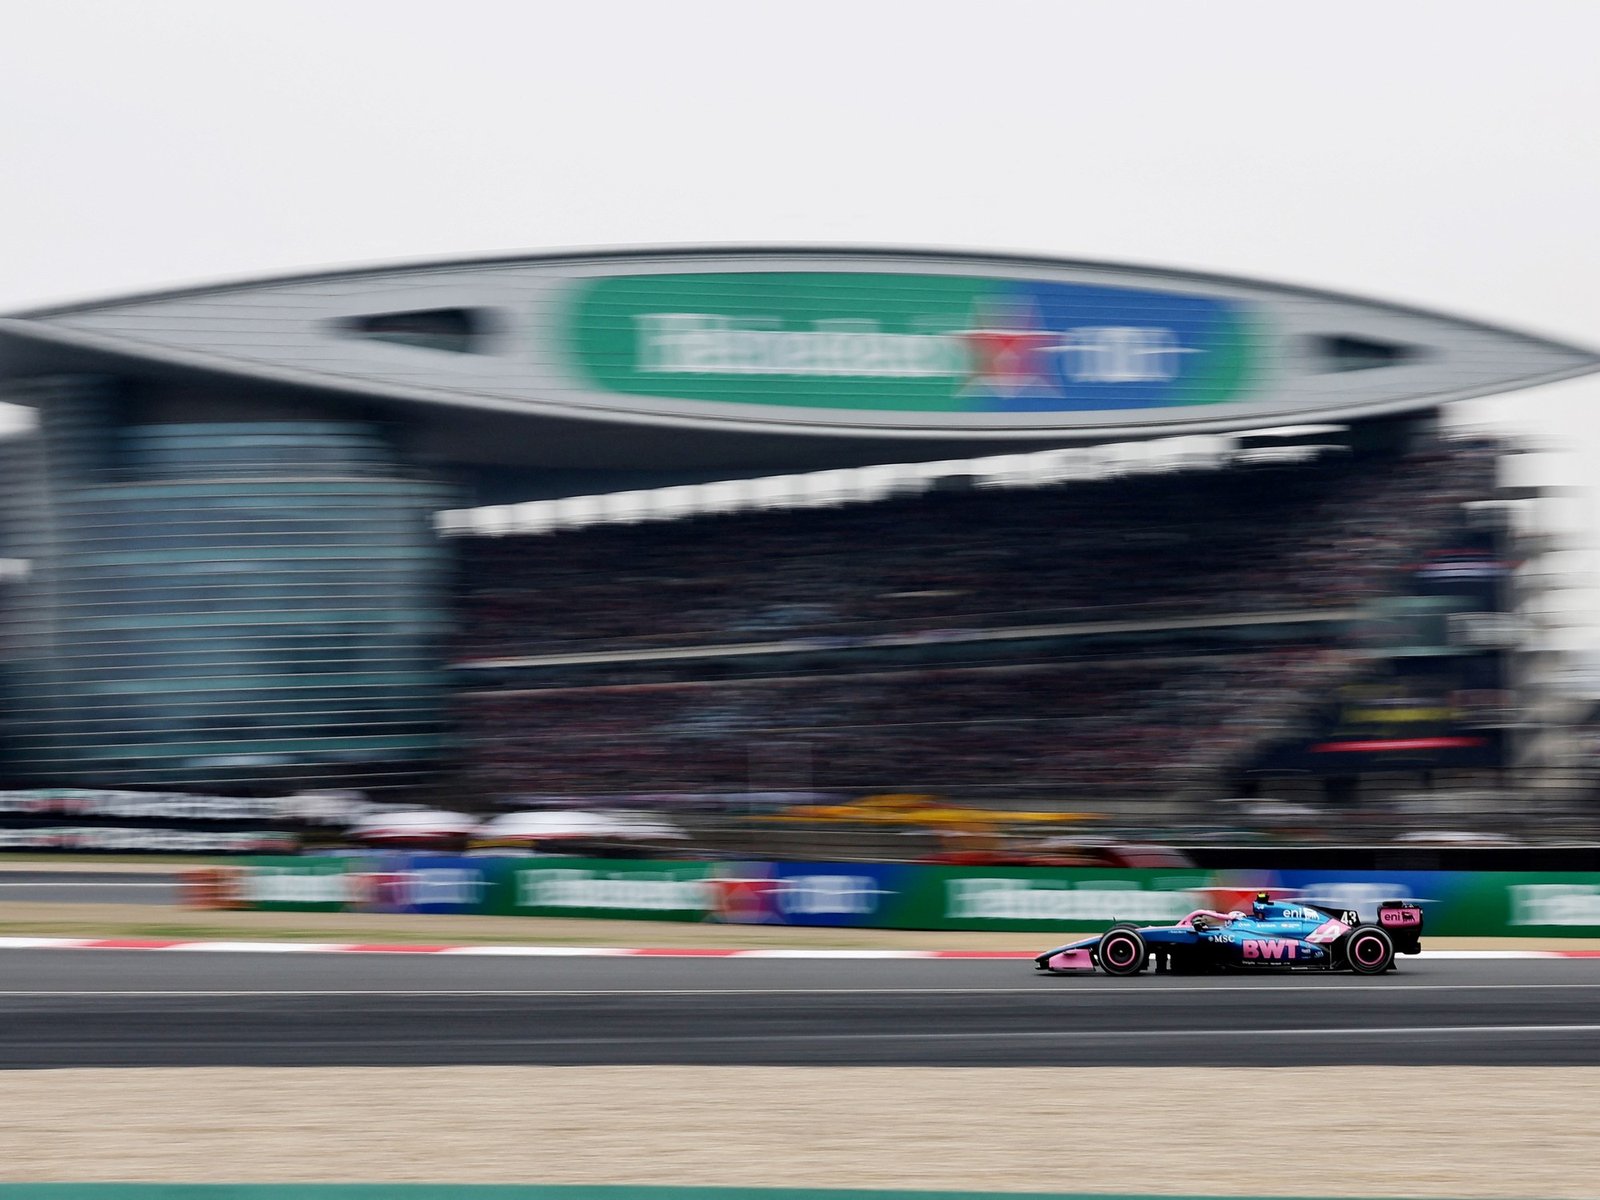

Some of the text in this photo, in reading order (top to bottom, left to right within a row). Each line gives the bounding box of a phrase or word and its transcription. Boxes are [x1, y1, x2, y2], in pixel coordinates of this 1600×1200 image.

[1283, 908, 1302, 918] eni
[1384, 912, 1400, 921] eni
[1341, 911, 1357, 926] 43
[1214, 935, 1235, 943] MSC
[1242, 939, 1299, 959] BWT
